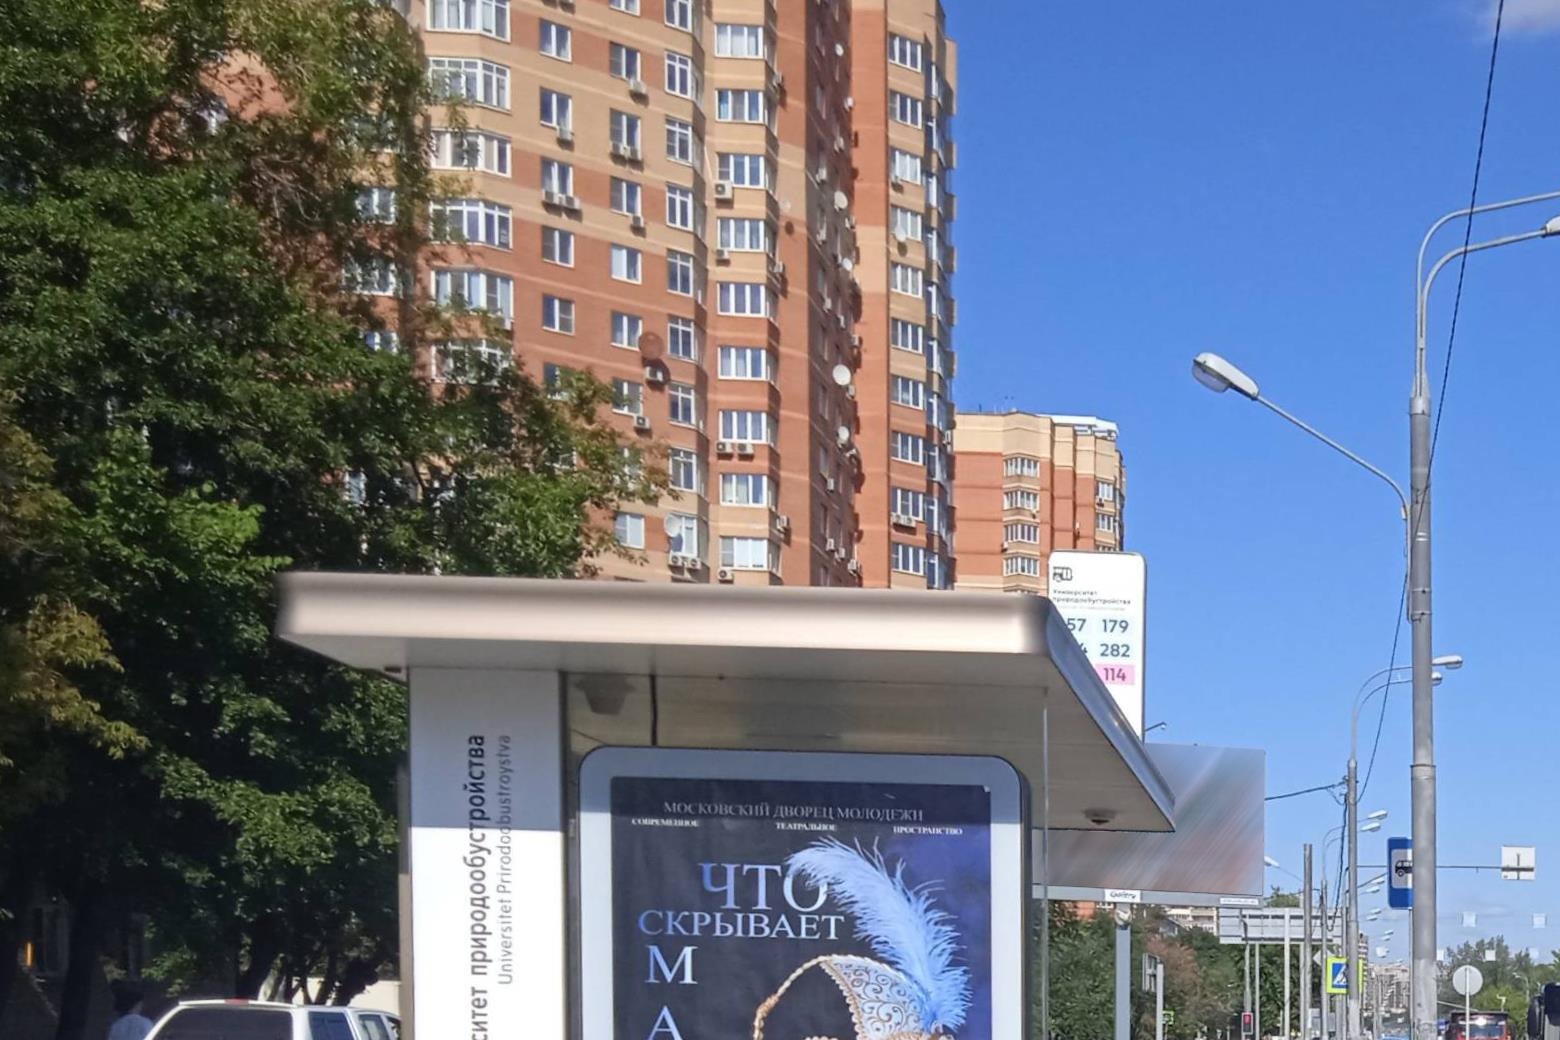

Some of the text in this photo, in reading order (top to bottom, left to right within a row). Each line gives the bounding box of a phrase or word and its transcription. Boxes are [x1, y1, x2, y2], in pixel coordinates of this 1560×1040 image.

[1102, 618, 1129, 634] 179
[1100, 643, 1130, 658] 282
[1103, 667, 1127, 682] 114
[664, 800, 924, 822] МОСКОВСКИЙ ДВОРЕЦ МОЛОДЕЖИ
[776, 821, 838, 832] ТЕАТРАЛЬНОЕ
[893, 825, 964, 836] ПРОСТРАНСТВО
[463, 734, 492, 976] природообустройства
[496, 734, 514, 986] Universitet Prirodoobustroystva
[698, 861, 829, 912] ЧТО
[637, 909, 845, 940] СКРЫВАЕТ
